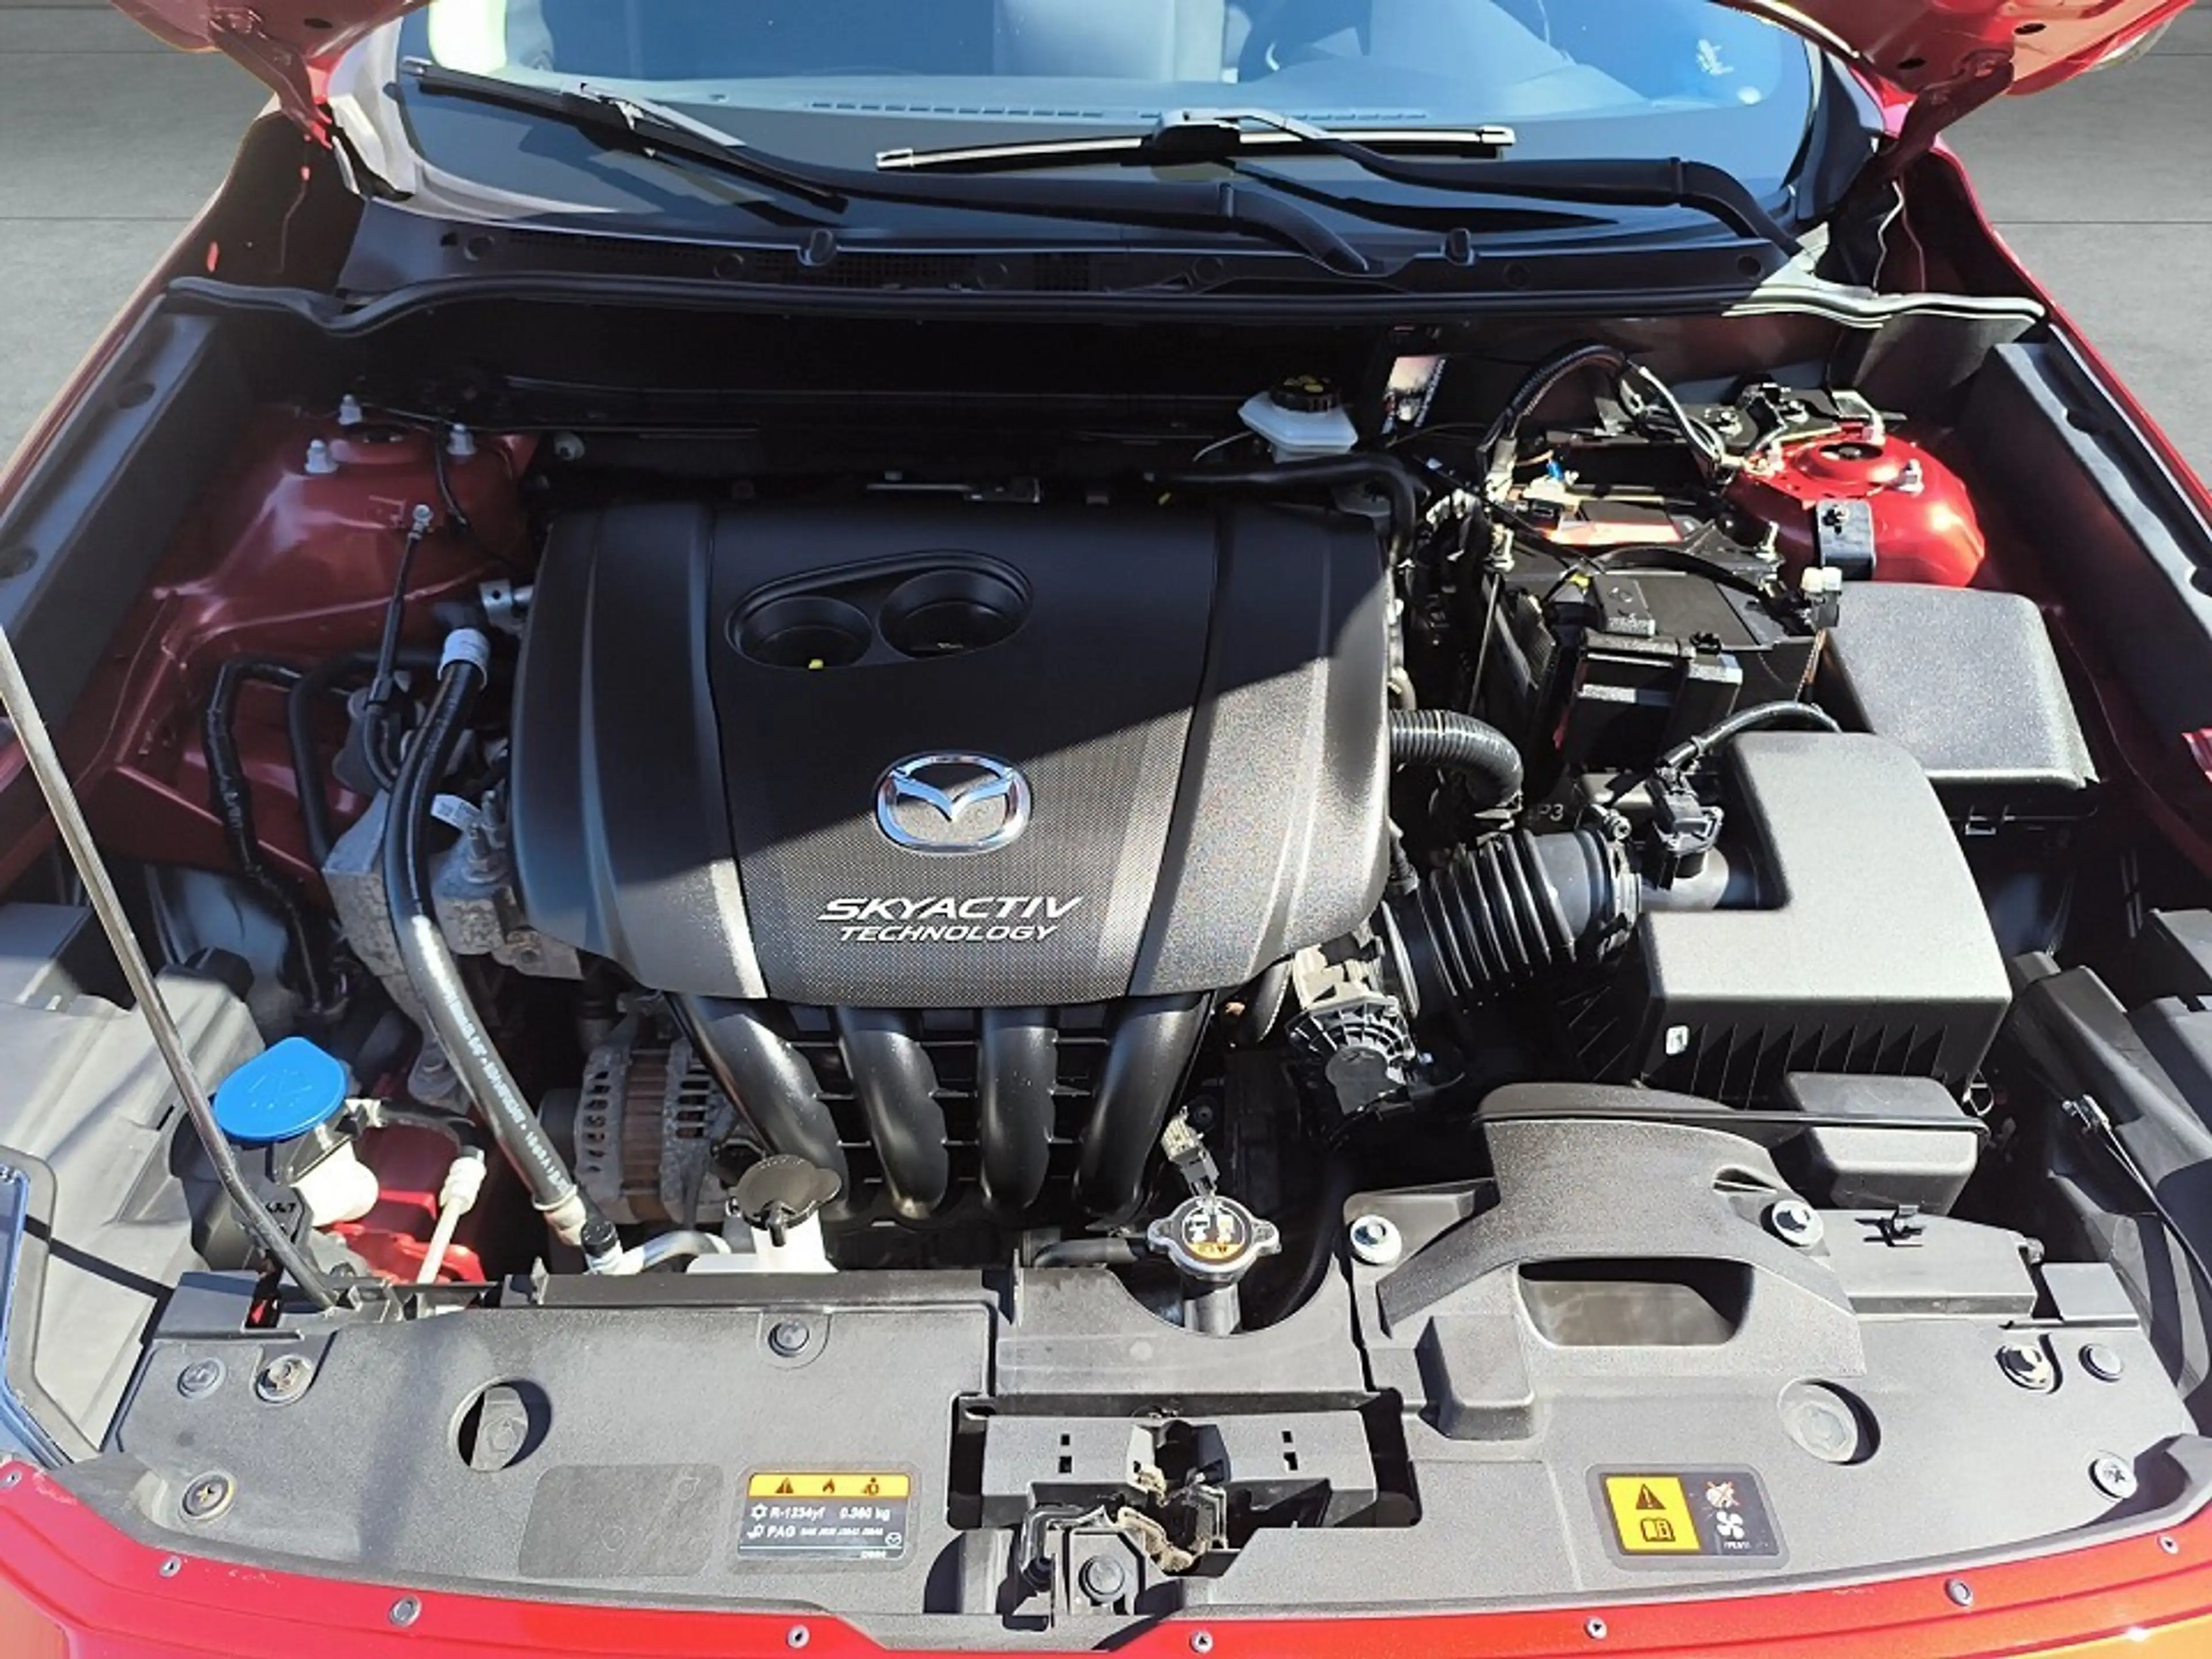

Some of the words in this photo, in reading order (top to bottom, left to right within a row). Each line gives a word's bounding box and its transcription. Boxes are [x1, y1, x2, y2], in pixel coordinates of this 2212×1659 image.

[817, 896, 1084, 921] SKYACTIV
[840, 925, 1059, 941] TECHNOLOGY
[875, 1507, 891, 1521] kg
[767, 1525, 796, 1538] PAG
